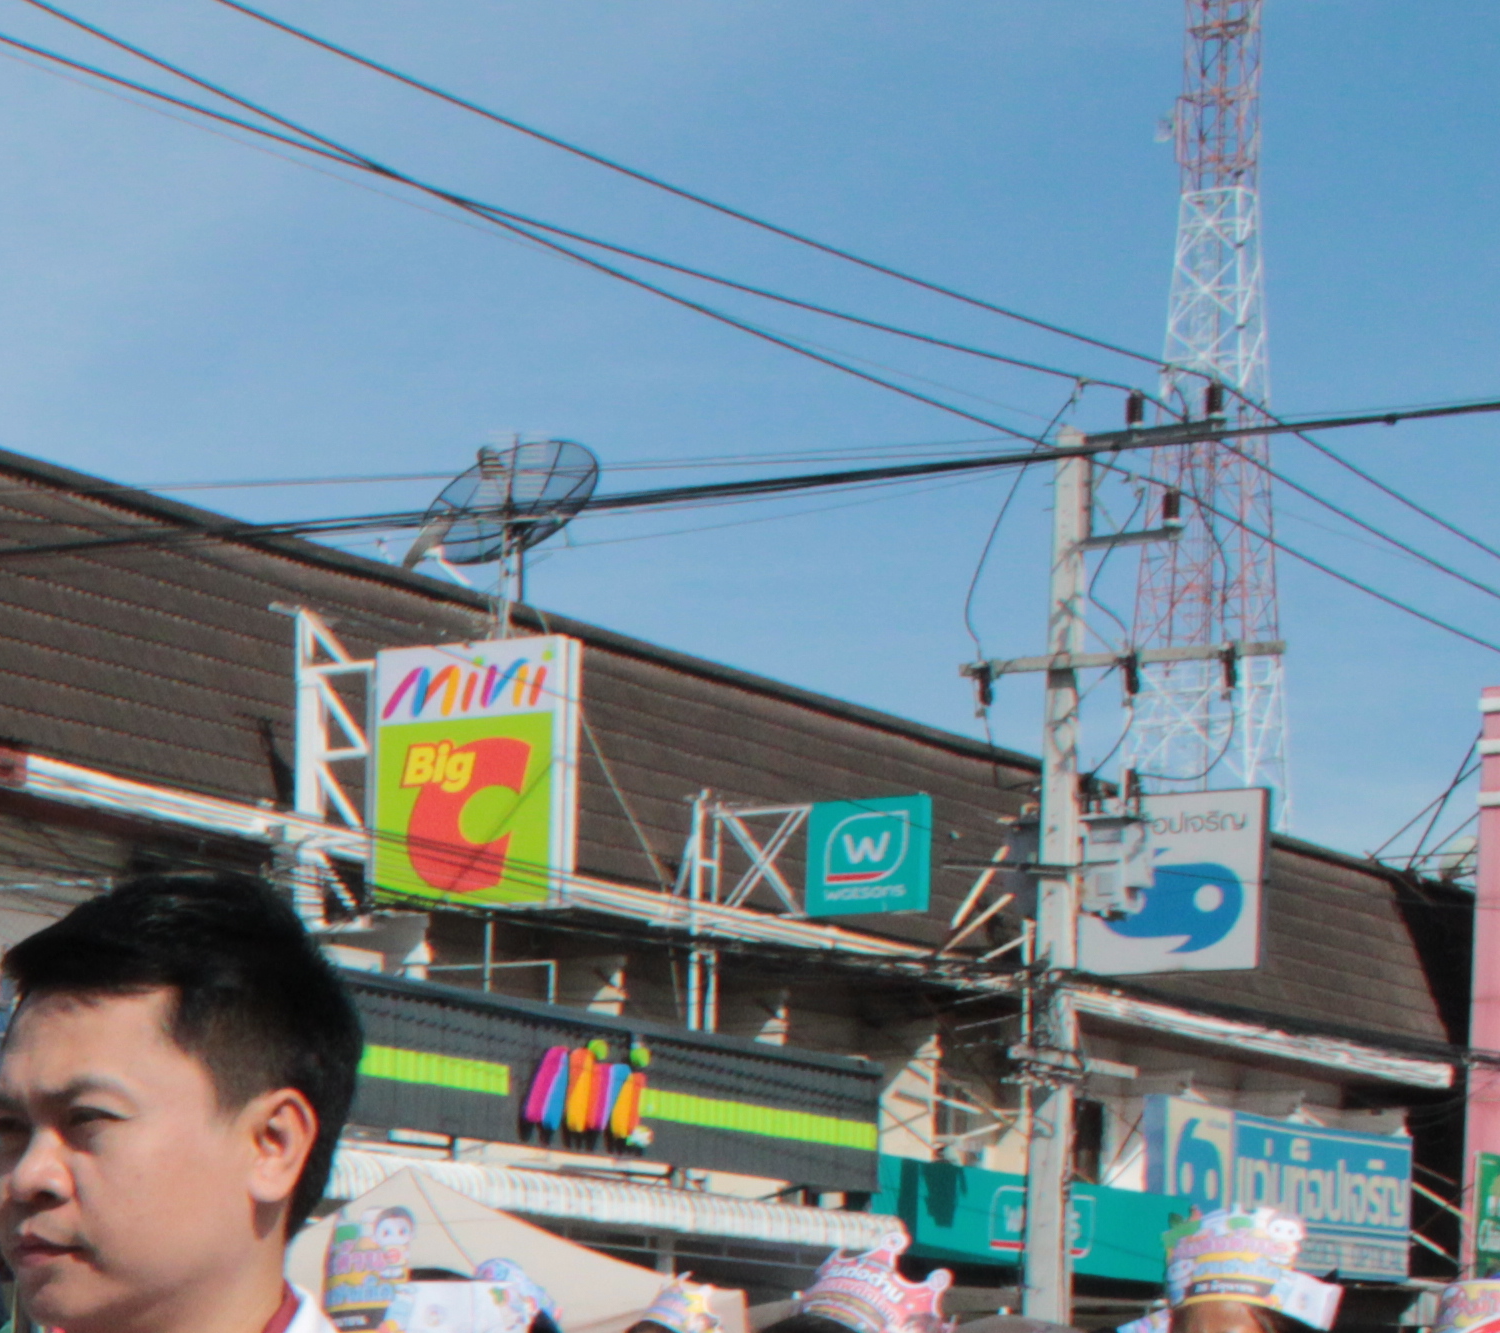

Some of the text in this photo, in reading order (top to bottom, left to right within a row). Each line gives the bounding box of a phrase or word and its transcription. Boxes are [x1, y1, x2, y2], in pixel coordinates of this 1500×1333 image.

[382, 650, 554, 720] mini
[401, 739, 477, 793] Big
[407, 736, 533, 894] C
[1150, 810, 1247, 835] อปเจริญ
